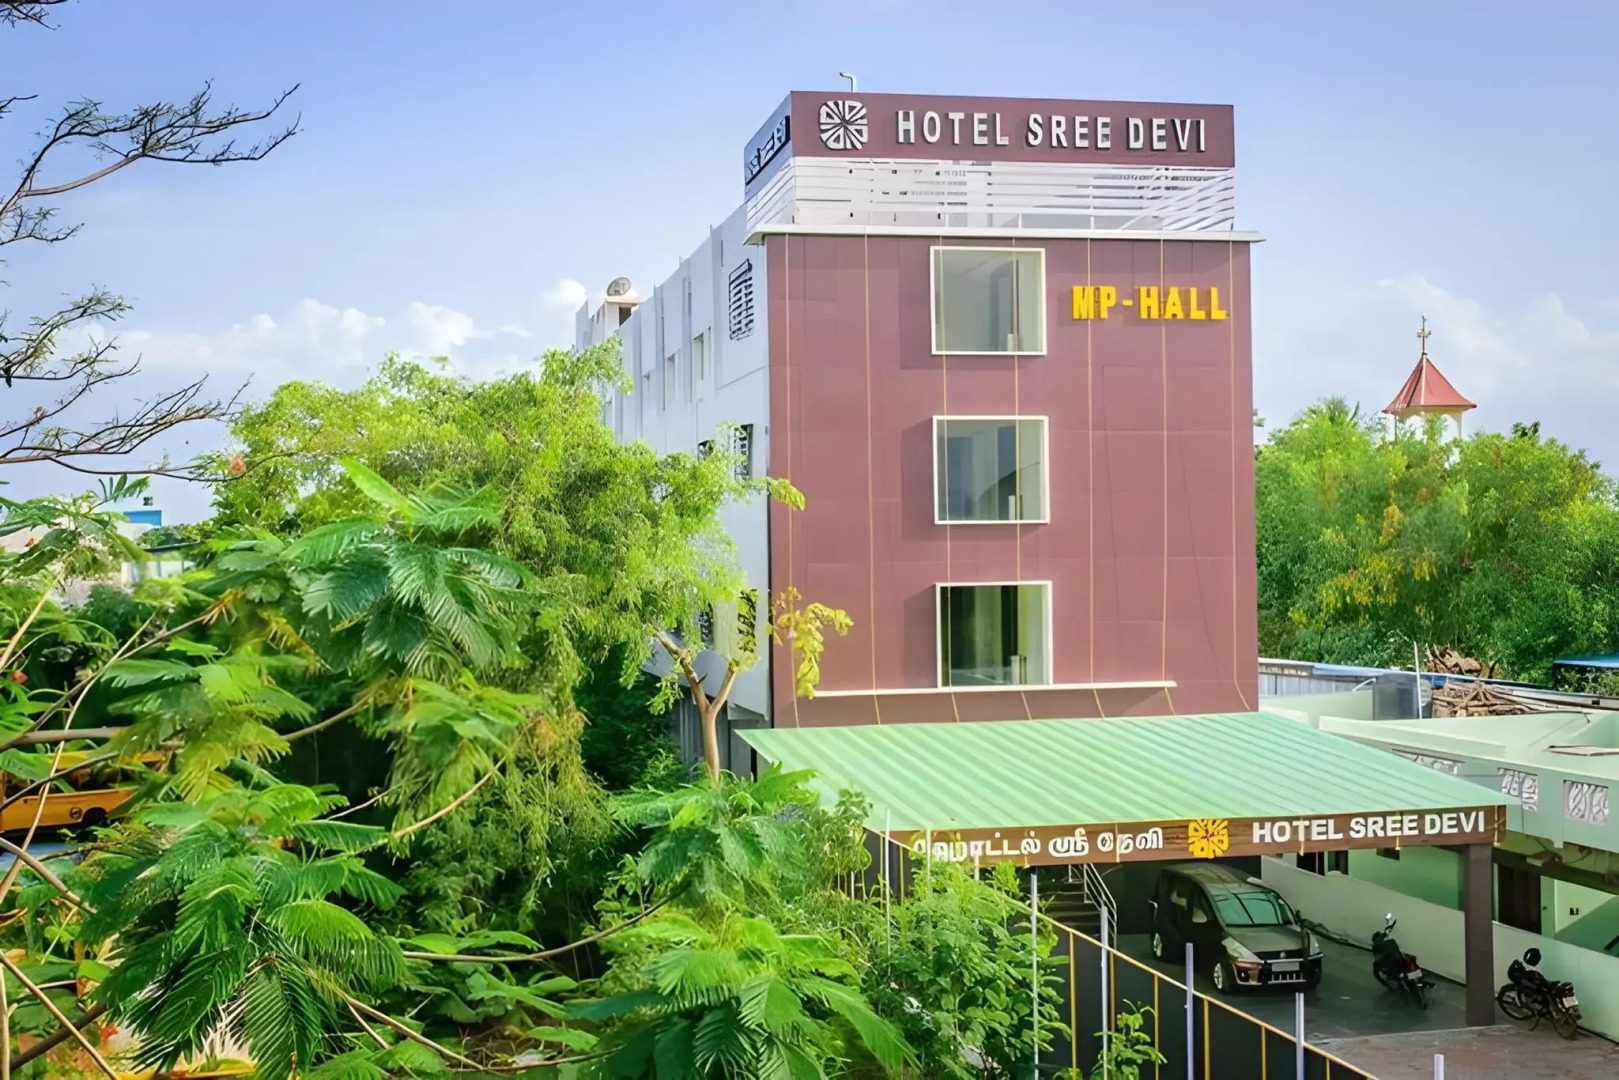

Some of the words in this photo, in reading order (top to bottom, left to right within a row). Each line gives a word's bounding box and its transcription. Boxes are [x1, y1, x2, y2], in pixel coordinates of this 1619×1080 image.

[898, 110, 1009, 145] HOTEL
[1027, 113, 1111, 149] SREE
[1128, 117, 1206, 152] DEVI
[1072, 285, 1228, 320] MP-HALL
[1252, 818, 1344, 843] HOTEL
[1349, 814, 1419, 839] SREE
[1424, 811, 1485, 835] DEVI
